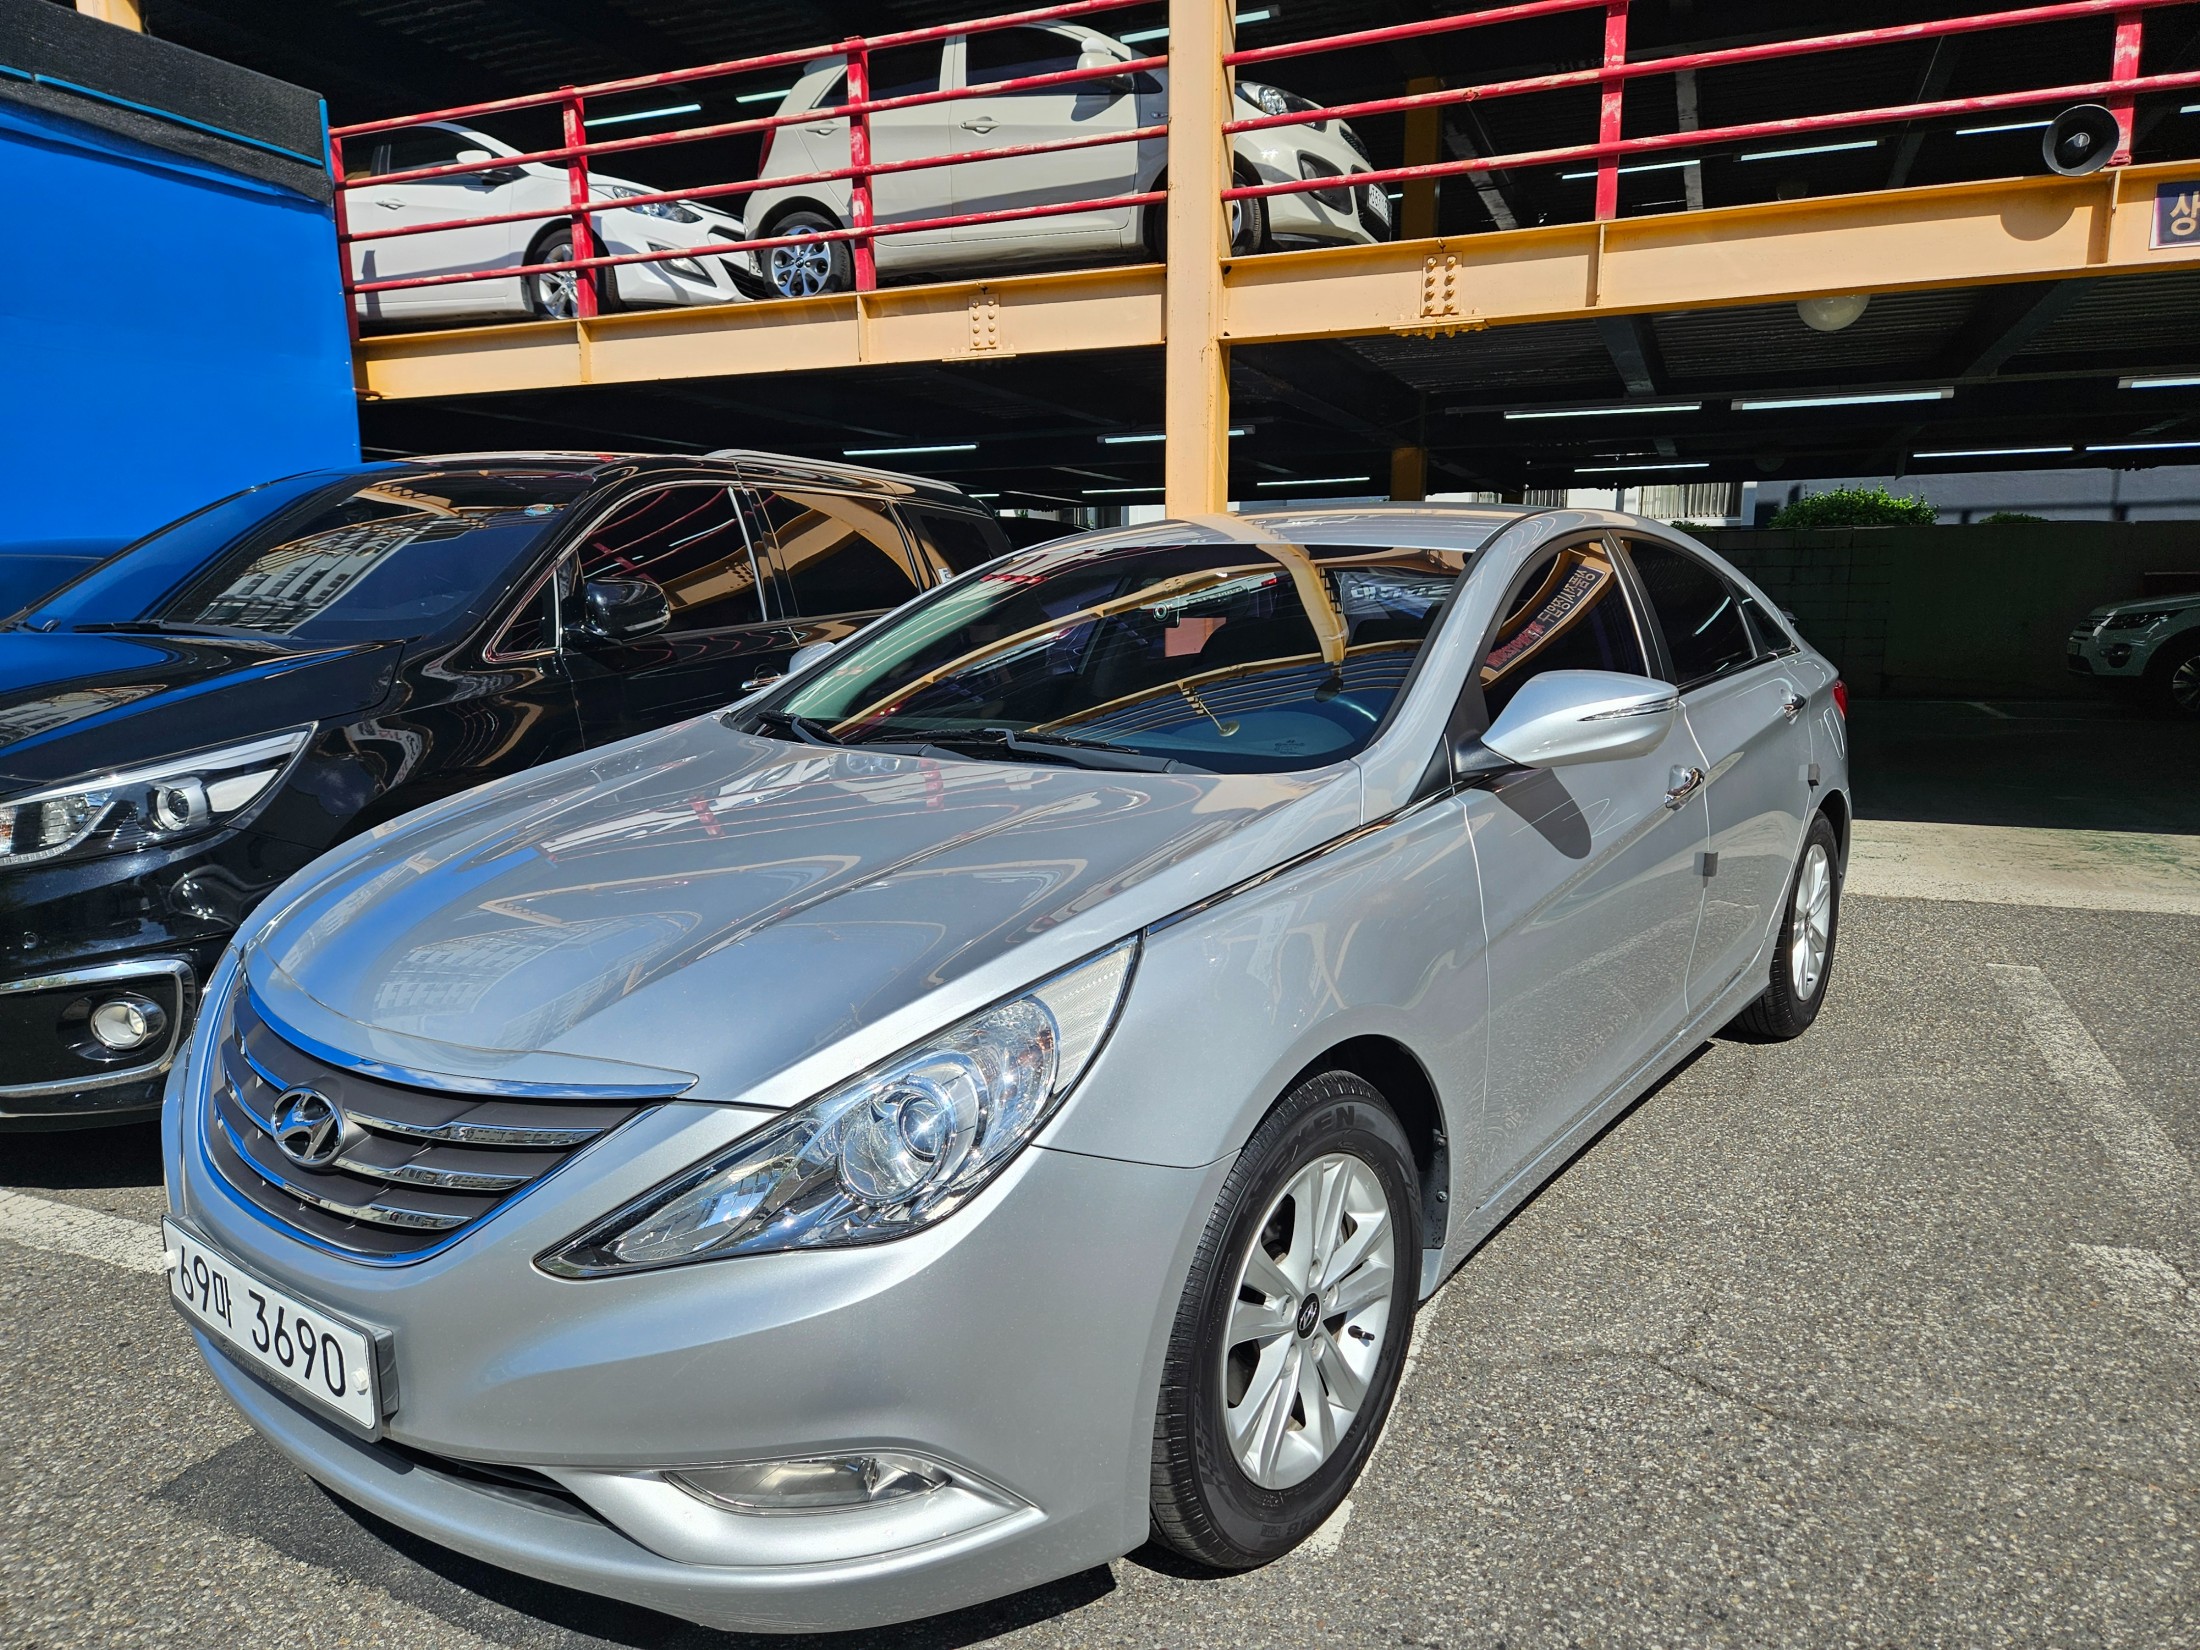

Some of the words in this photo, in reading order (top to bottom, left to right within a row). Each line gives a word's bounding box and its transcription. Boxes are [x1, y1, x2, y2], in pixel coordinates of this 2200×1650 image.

[2169, 191, 2200, 236] 상
[180, 1245, 232, 1329] 69마
[248, 1288, 347, 1398] 3690
